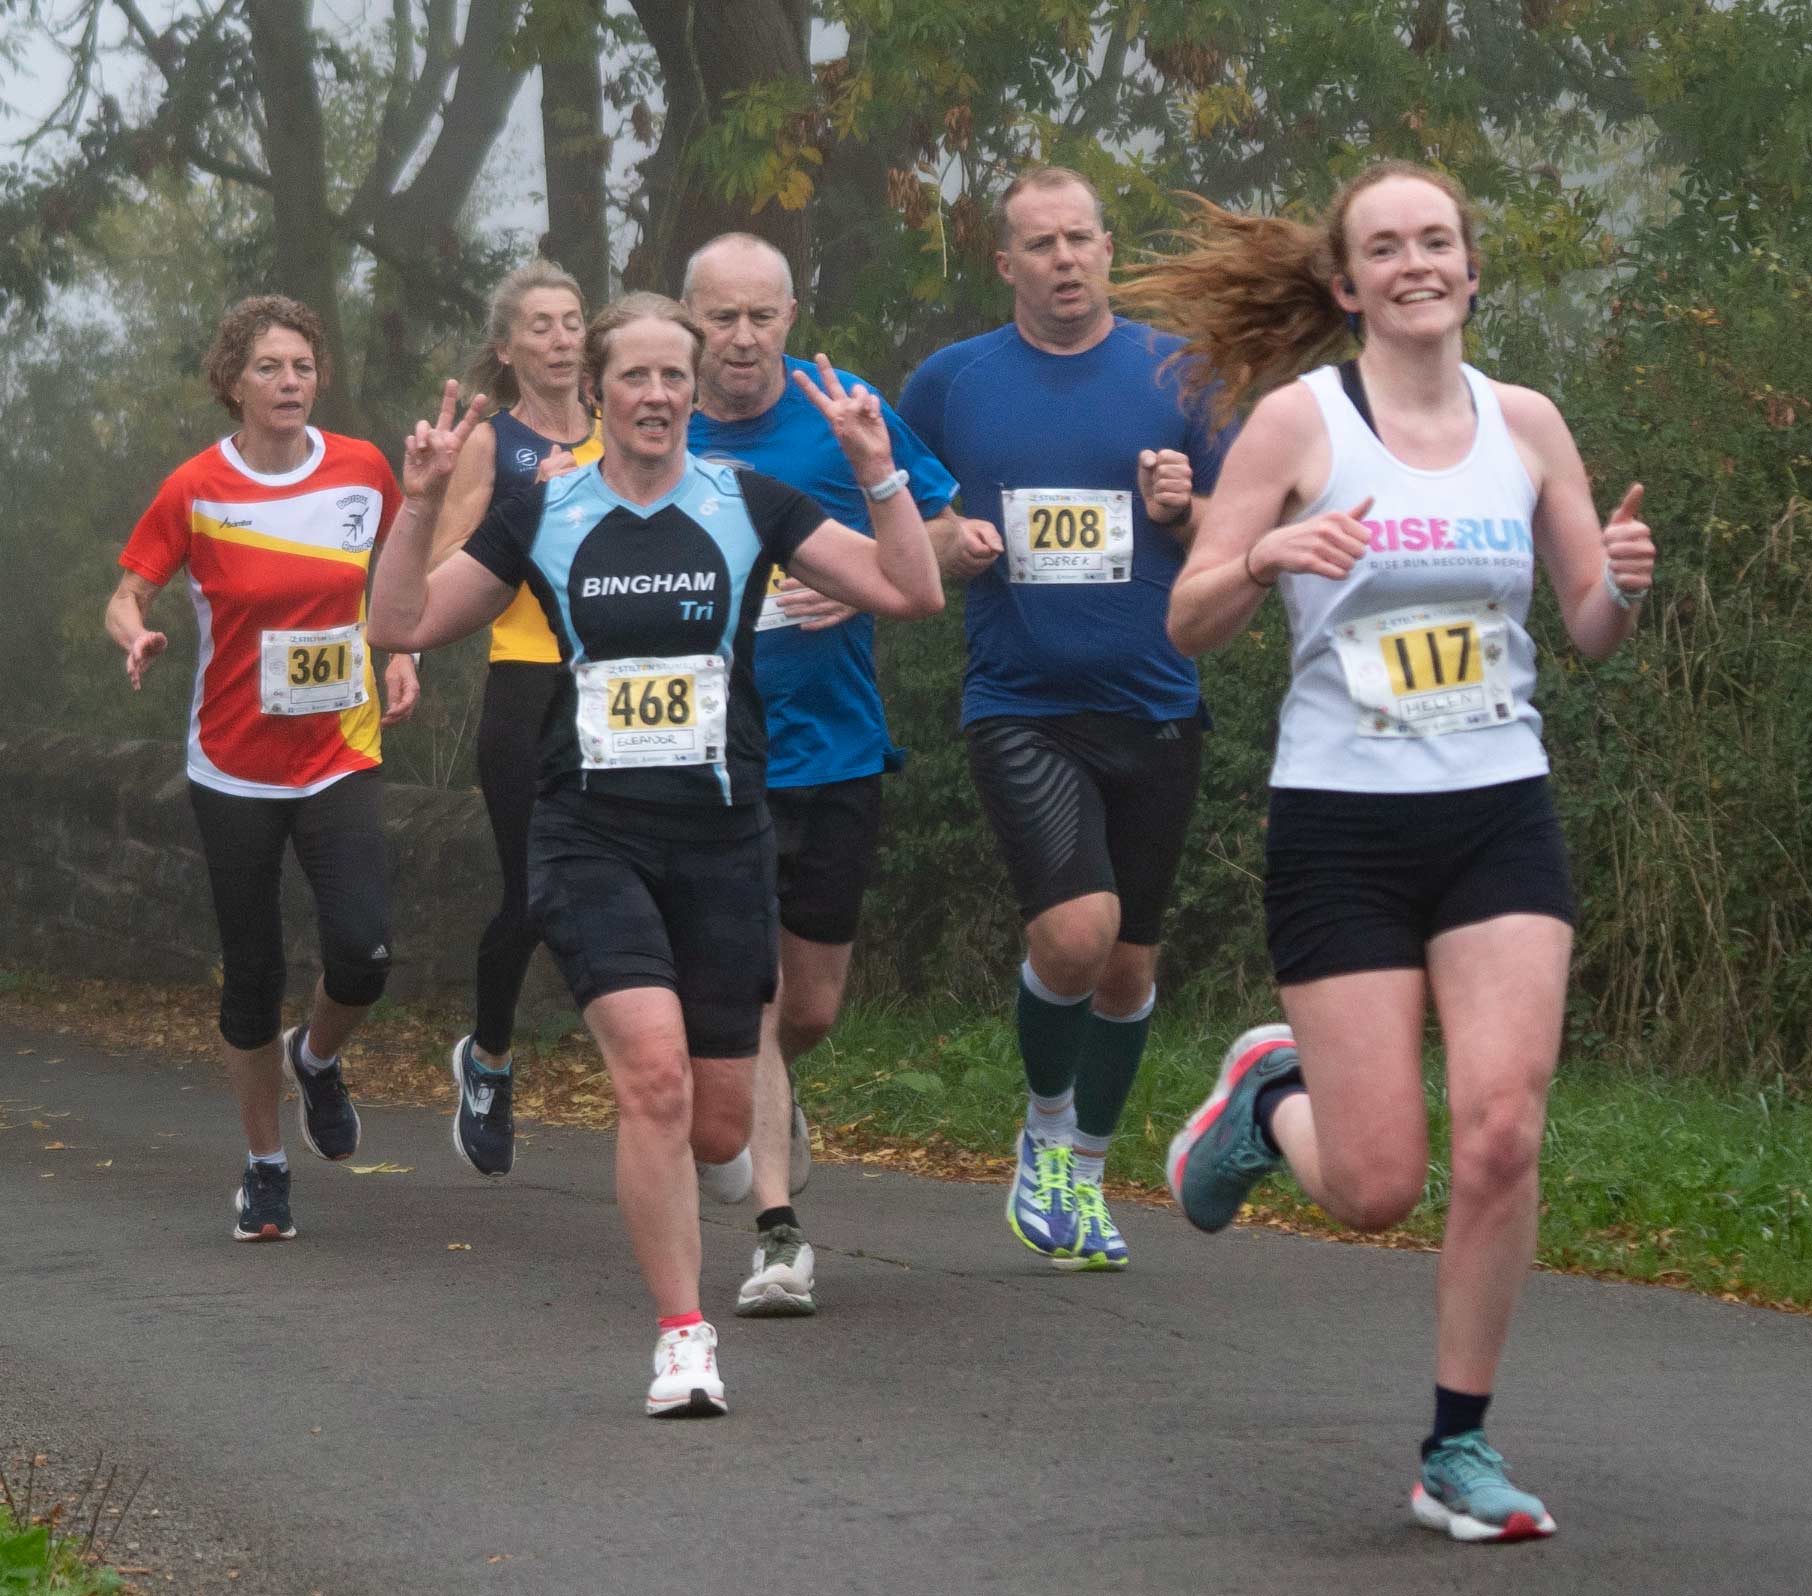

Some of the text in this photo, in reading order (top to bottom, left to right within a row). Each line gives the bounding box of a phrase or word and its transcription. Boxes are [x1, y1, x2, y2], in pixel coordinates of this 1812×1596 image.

[1032, 508, 1101, 549] 208
[1041, 556, 1090, 567] DEREK
[582, 571, 717, 598] BINGHAM
[679, 600, 715, 621] Tri
[290, 645, 345, 685] 361
[1395, 627, 1471, 690] 117
[611, 678, 690, 727] 468
[1406, 694, 1473, 715] HELEN
